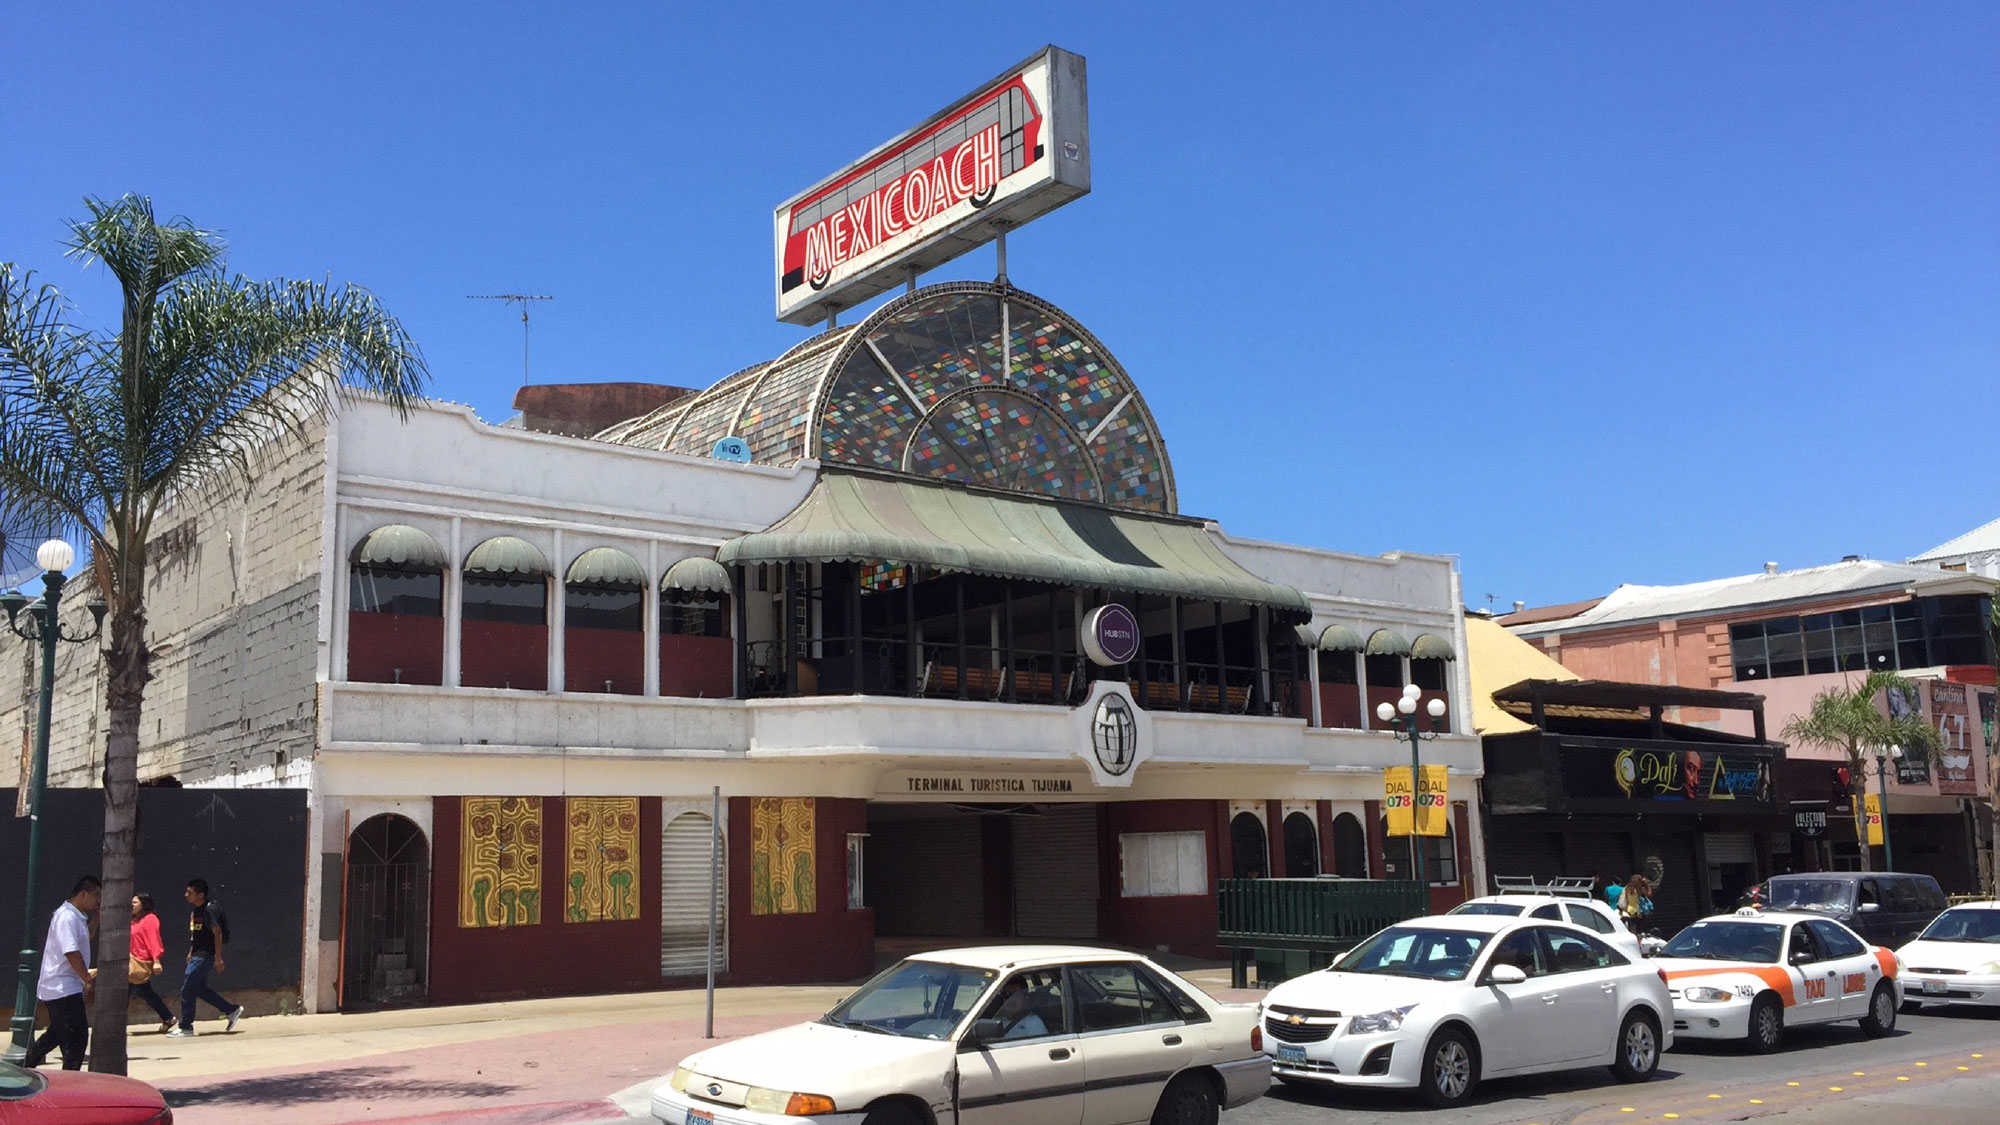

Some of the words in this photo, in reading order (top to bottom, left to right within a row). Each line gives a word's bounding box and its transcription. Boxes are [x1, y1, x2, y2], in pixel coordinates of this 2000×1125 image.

[805, 124, 1000, 281] MEXICOACH
[908, 778, 963, 791] TERMINAL
[970, 779, 1025, 791] TURISTICA
[1032, 780, 1072, 792] TIJUANA
[1386, 782, 1411, 794] DIAL
[1419, 781, 1446, 792] DIAL
[1387, 795, 1411, 807] 078
[1418, 795, 1445, 806] 078
[1735, 985, 1756, 997] 7492
[1804, 978, 1825, 999] TAXI
